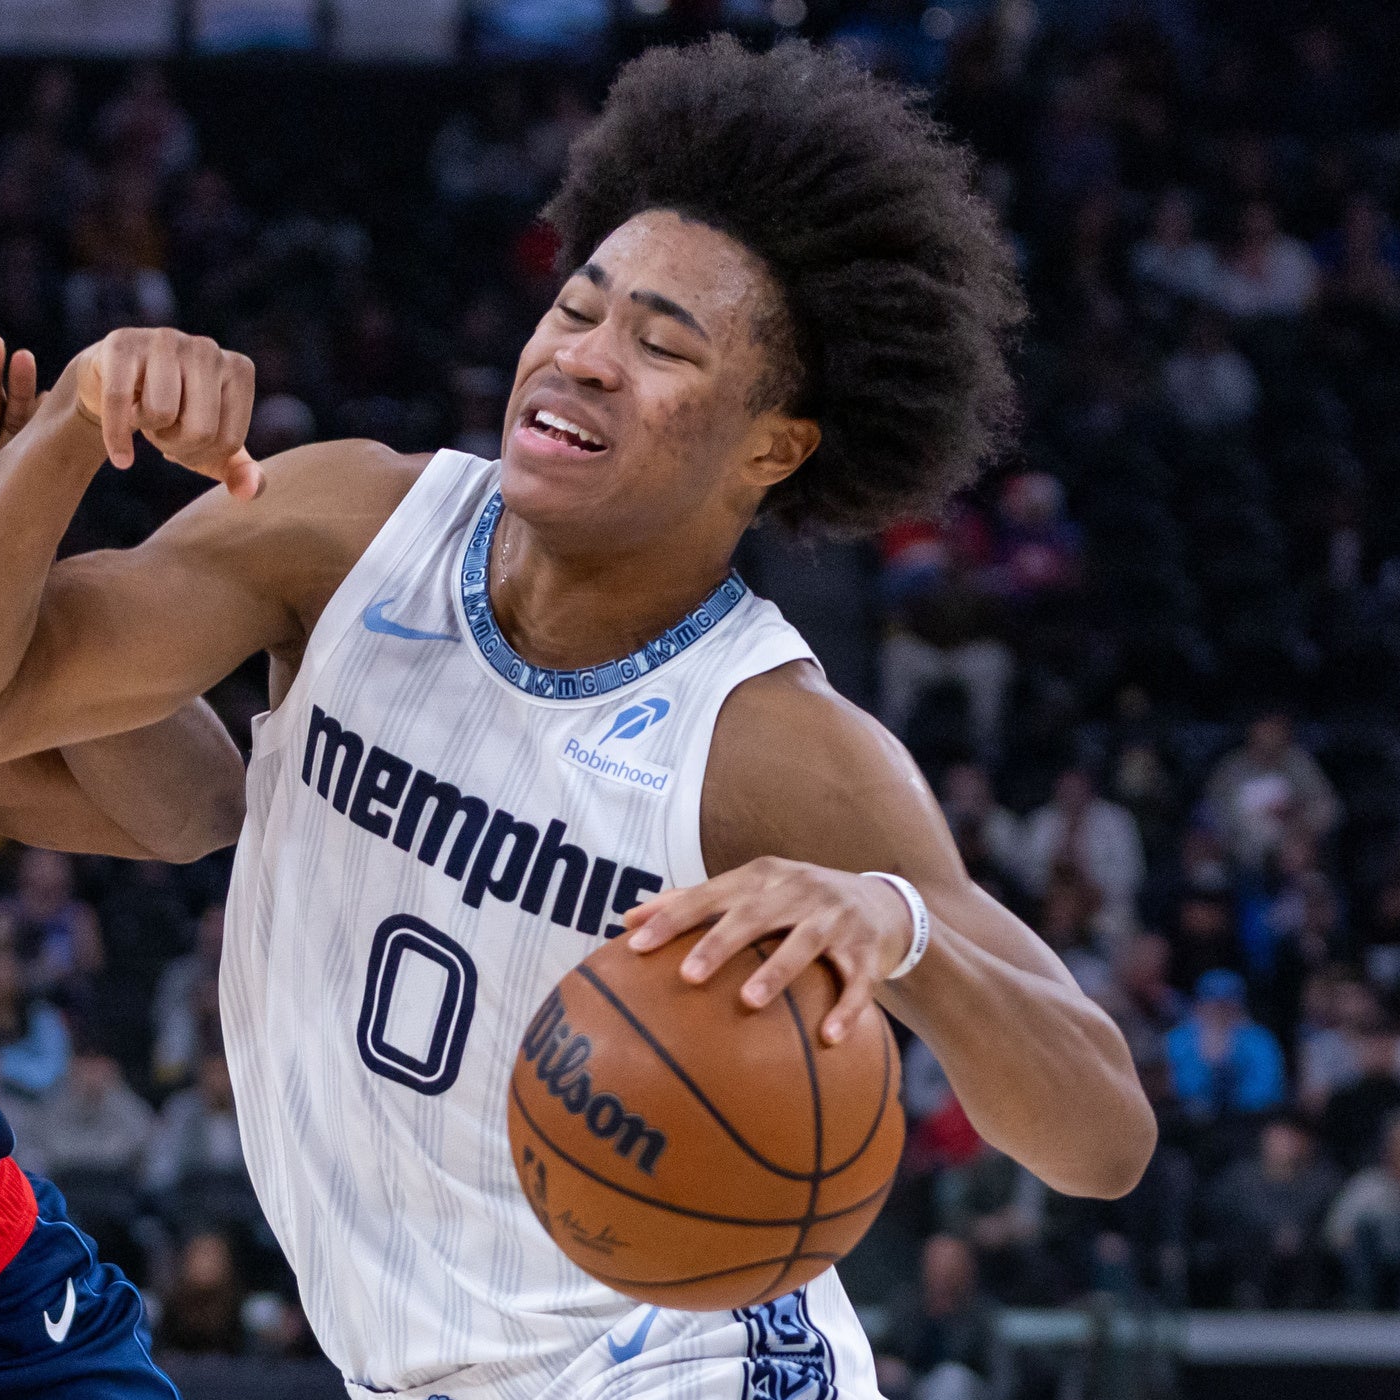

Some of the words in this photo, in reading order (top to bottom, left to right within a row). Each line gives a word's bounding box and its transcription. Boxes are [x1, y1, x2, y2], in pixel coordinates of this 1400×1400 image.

[301, 704, 663, 939] memphis
[564, 738, 668, 790] Robinhood
[357, 913, 478, 1096] 0
